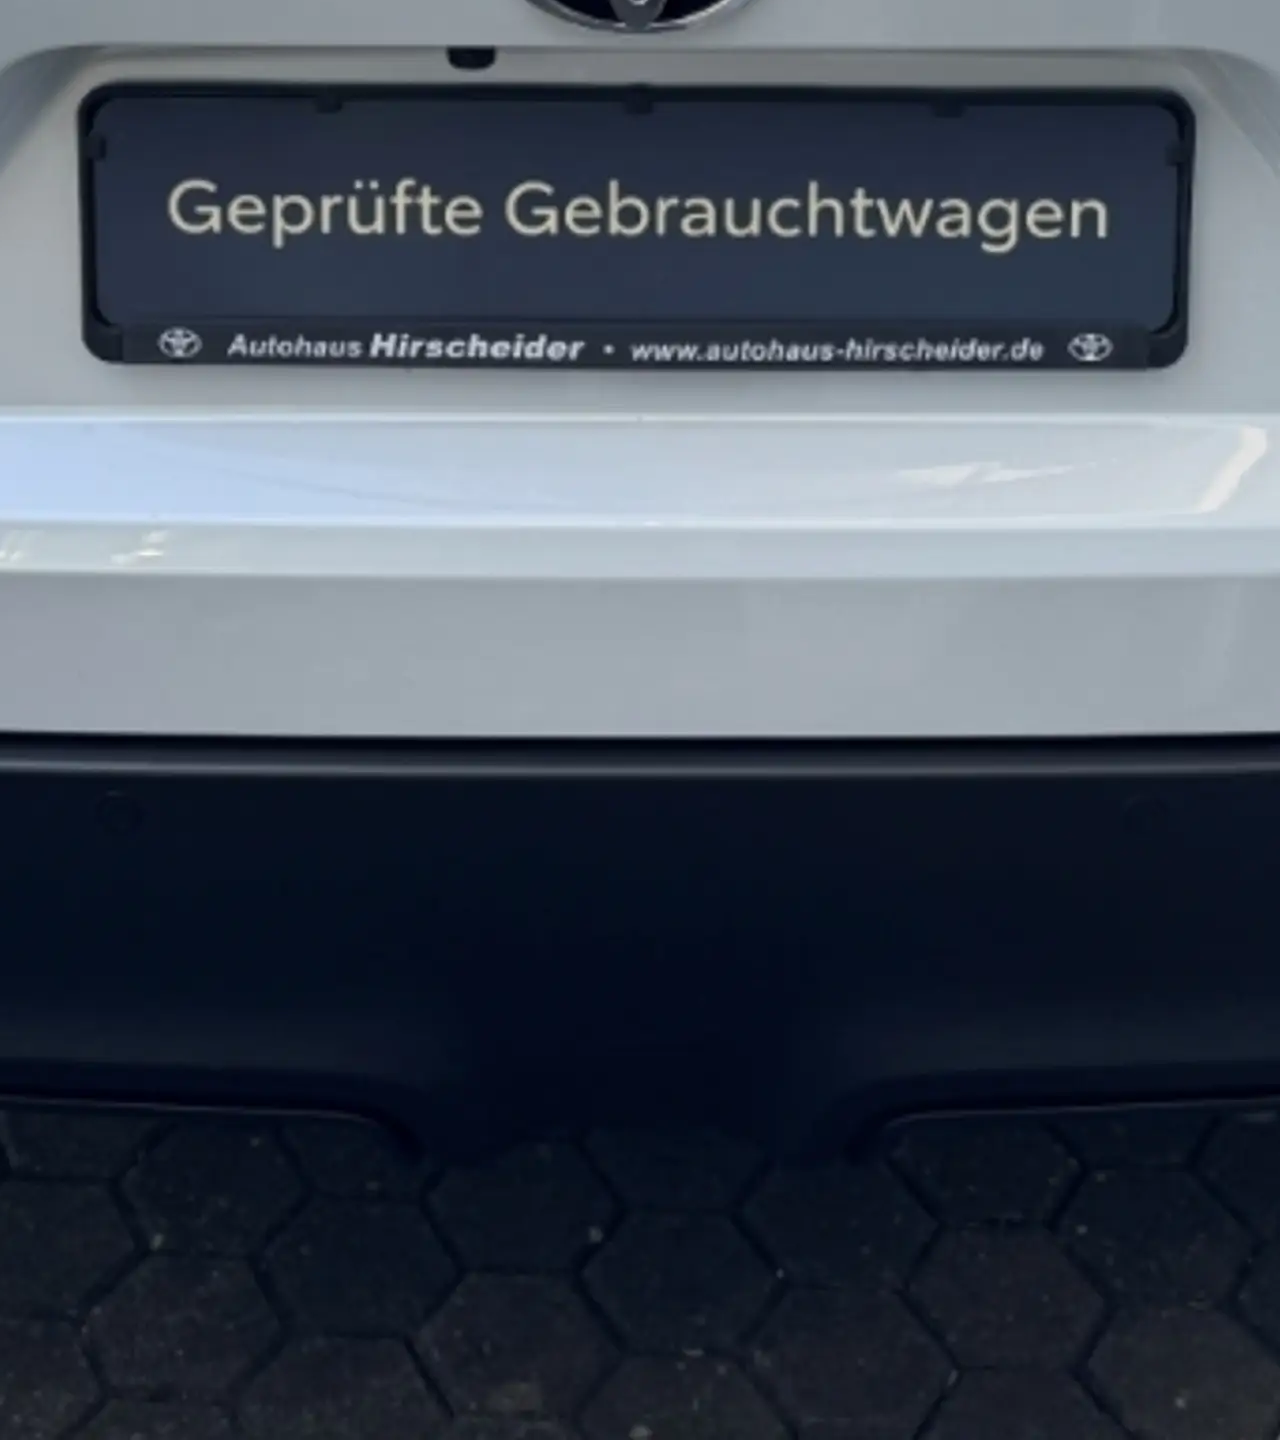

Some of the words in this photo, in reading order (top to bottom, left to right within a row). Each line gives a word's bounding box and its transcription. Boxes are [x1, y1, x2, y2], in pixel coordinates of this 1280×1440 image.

[166, 177, 483, 248] Geprüfte
[504, 179, 1110, 254] Gebrauchtwagen
[227, 333, 362, 358] Autohaus
[369, 332, 585, 360] Hirscheider
[631, 337, 1045, 362] www.autohaus-hirscheider.de
